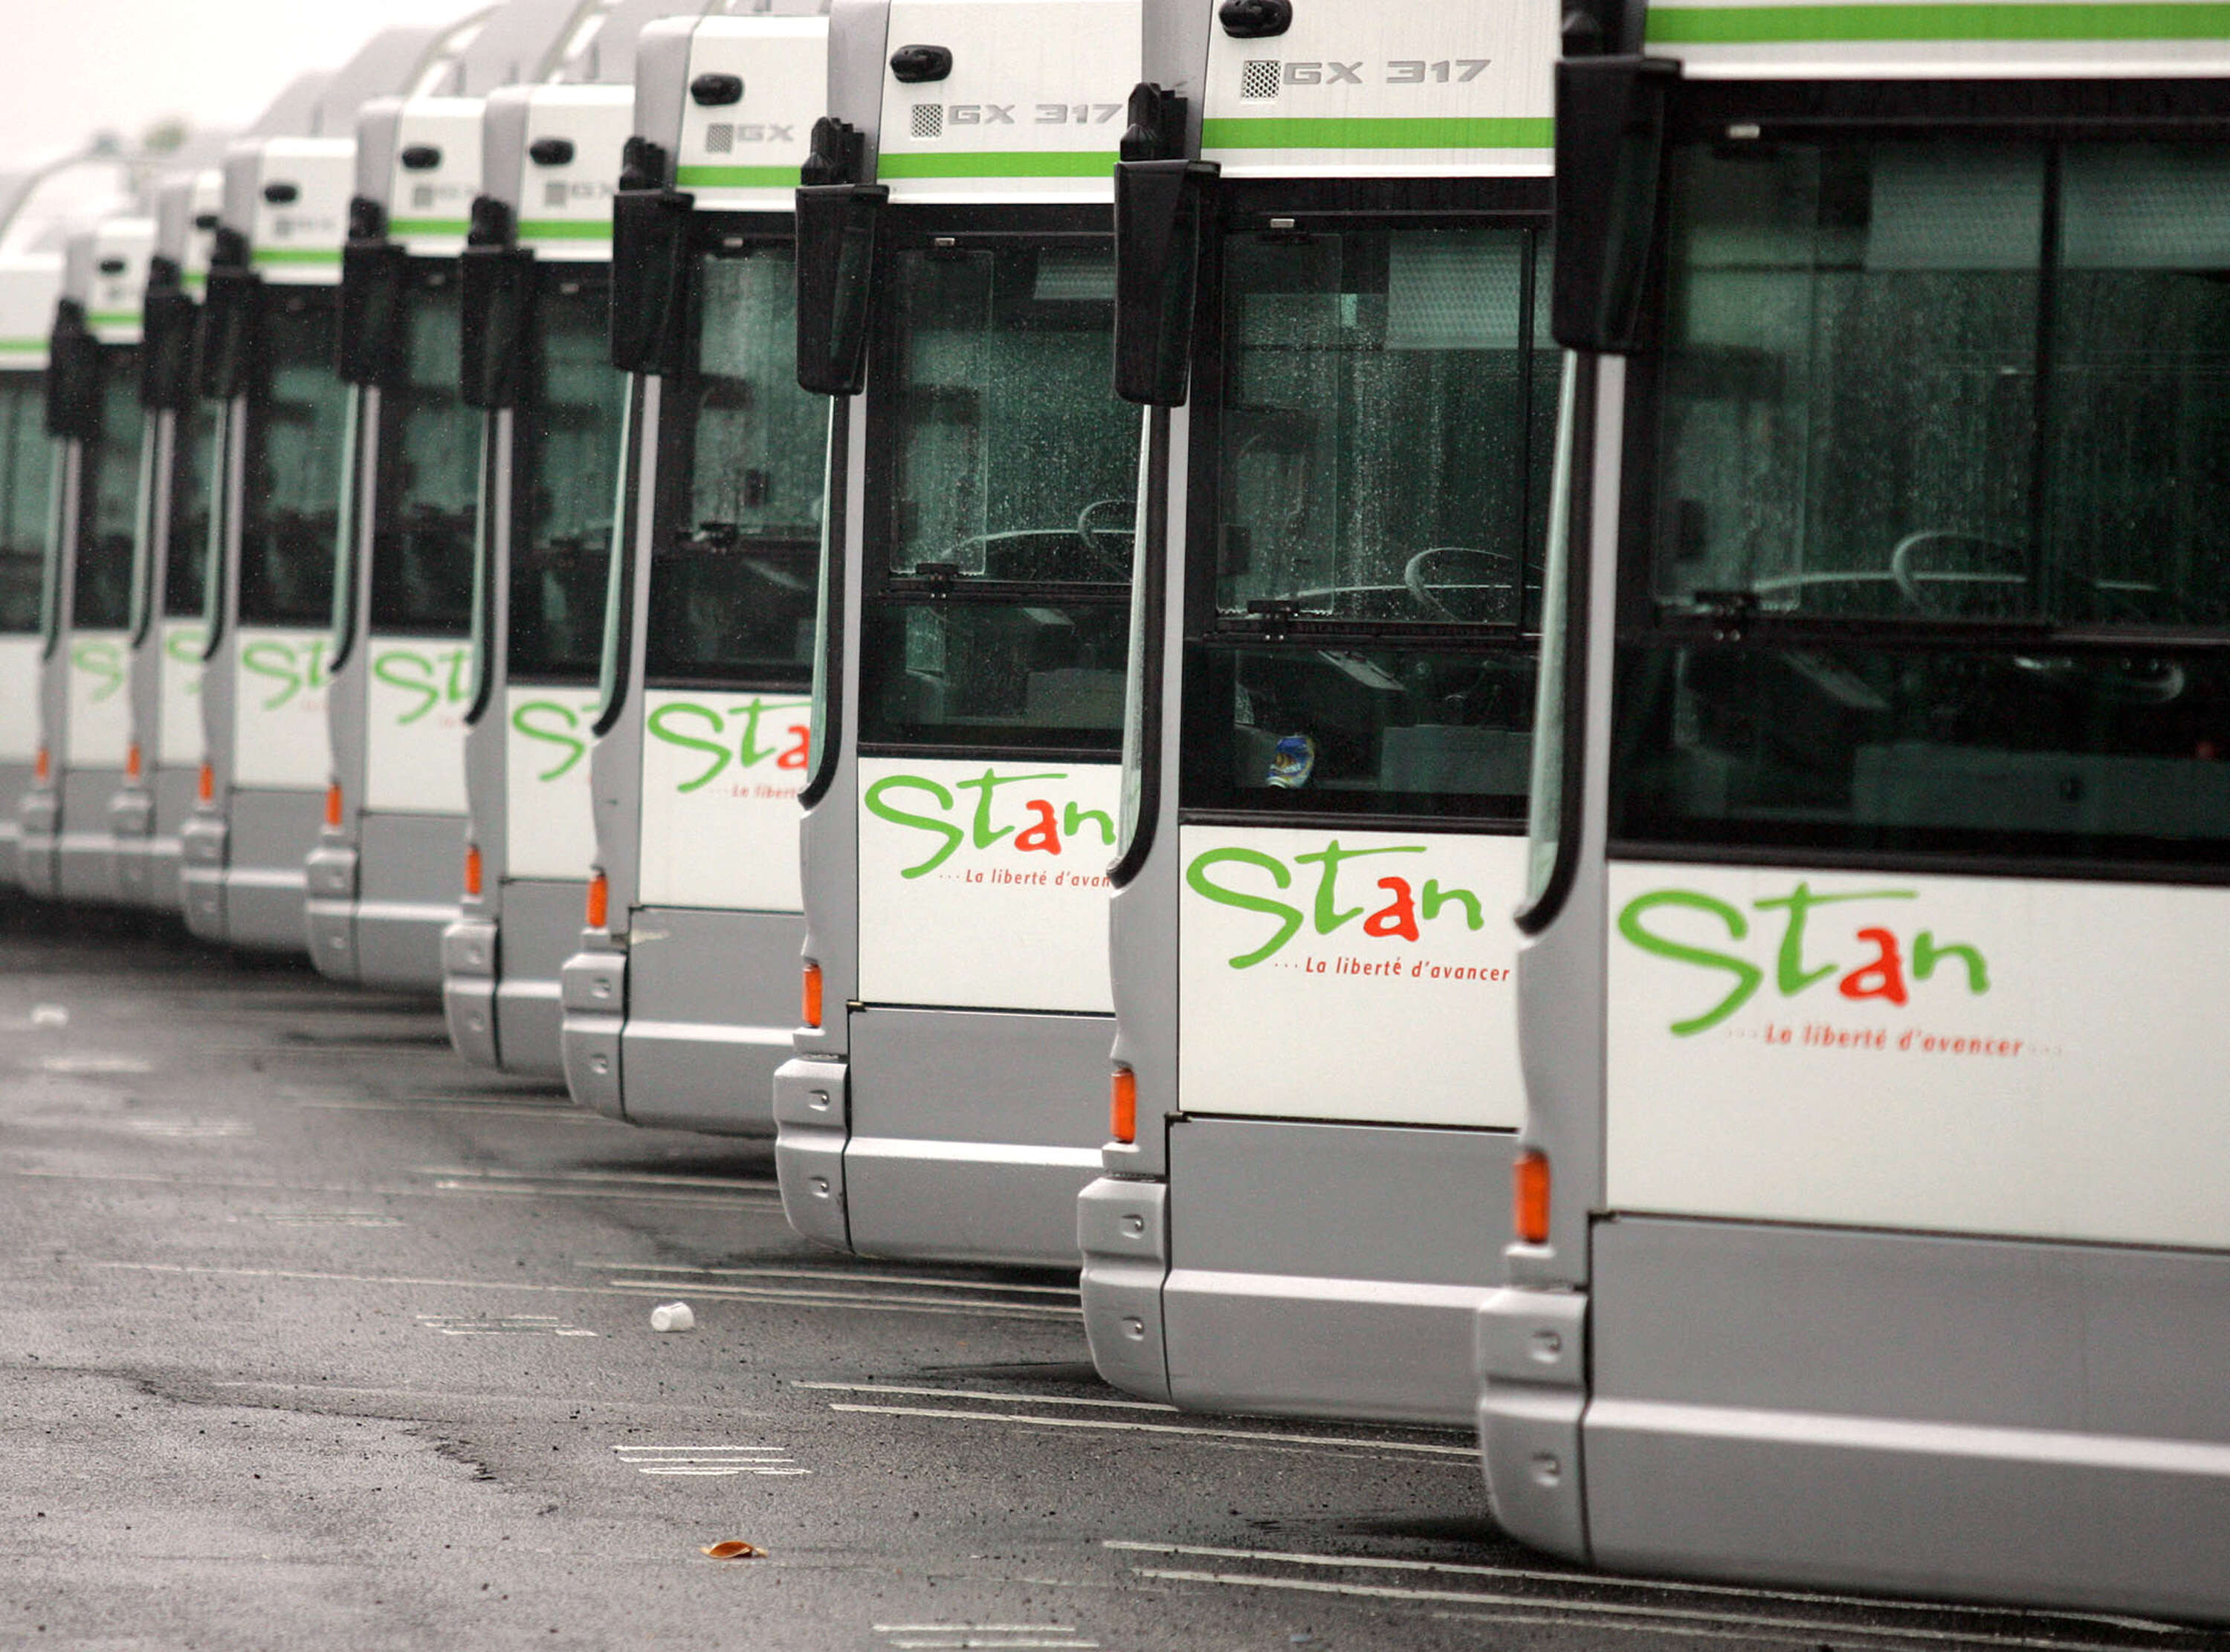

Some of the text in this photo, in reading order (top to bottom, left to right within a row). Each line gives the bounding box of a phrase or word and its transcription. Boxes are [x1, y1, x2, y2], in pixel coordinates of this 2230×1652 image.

[1283, 59, 1491, 85] GX 317
[948, 104, 1123, 125] GX 317
[737, 124, 794, 142] GX
[864, 768, 1117, 880] Stan
[966, 869, 984, 884] La
[991, 869, 1047, 886] liberté
[1185, 839, 1485, 970] Stan
[1305, 956, 1510, 982] La liberté d'avancer
[1616, 881, 1991, 1037] Stan
[1765, 1023, 2025, 1057] La liberté d'avancer
